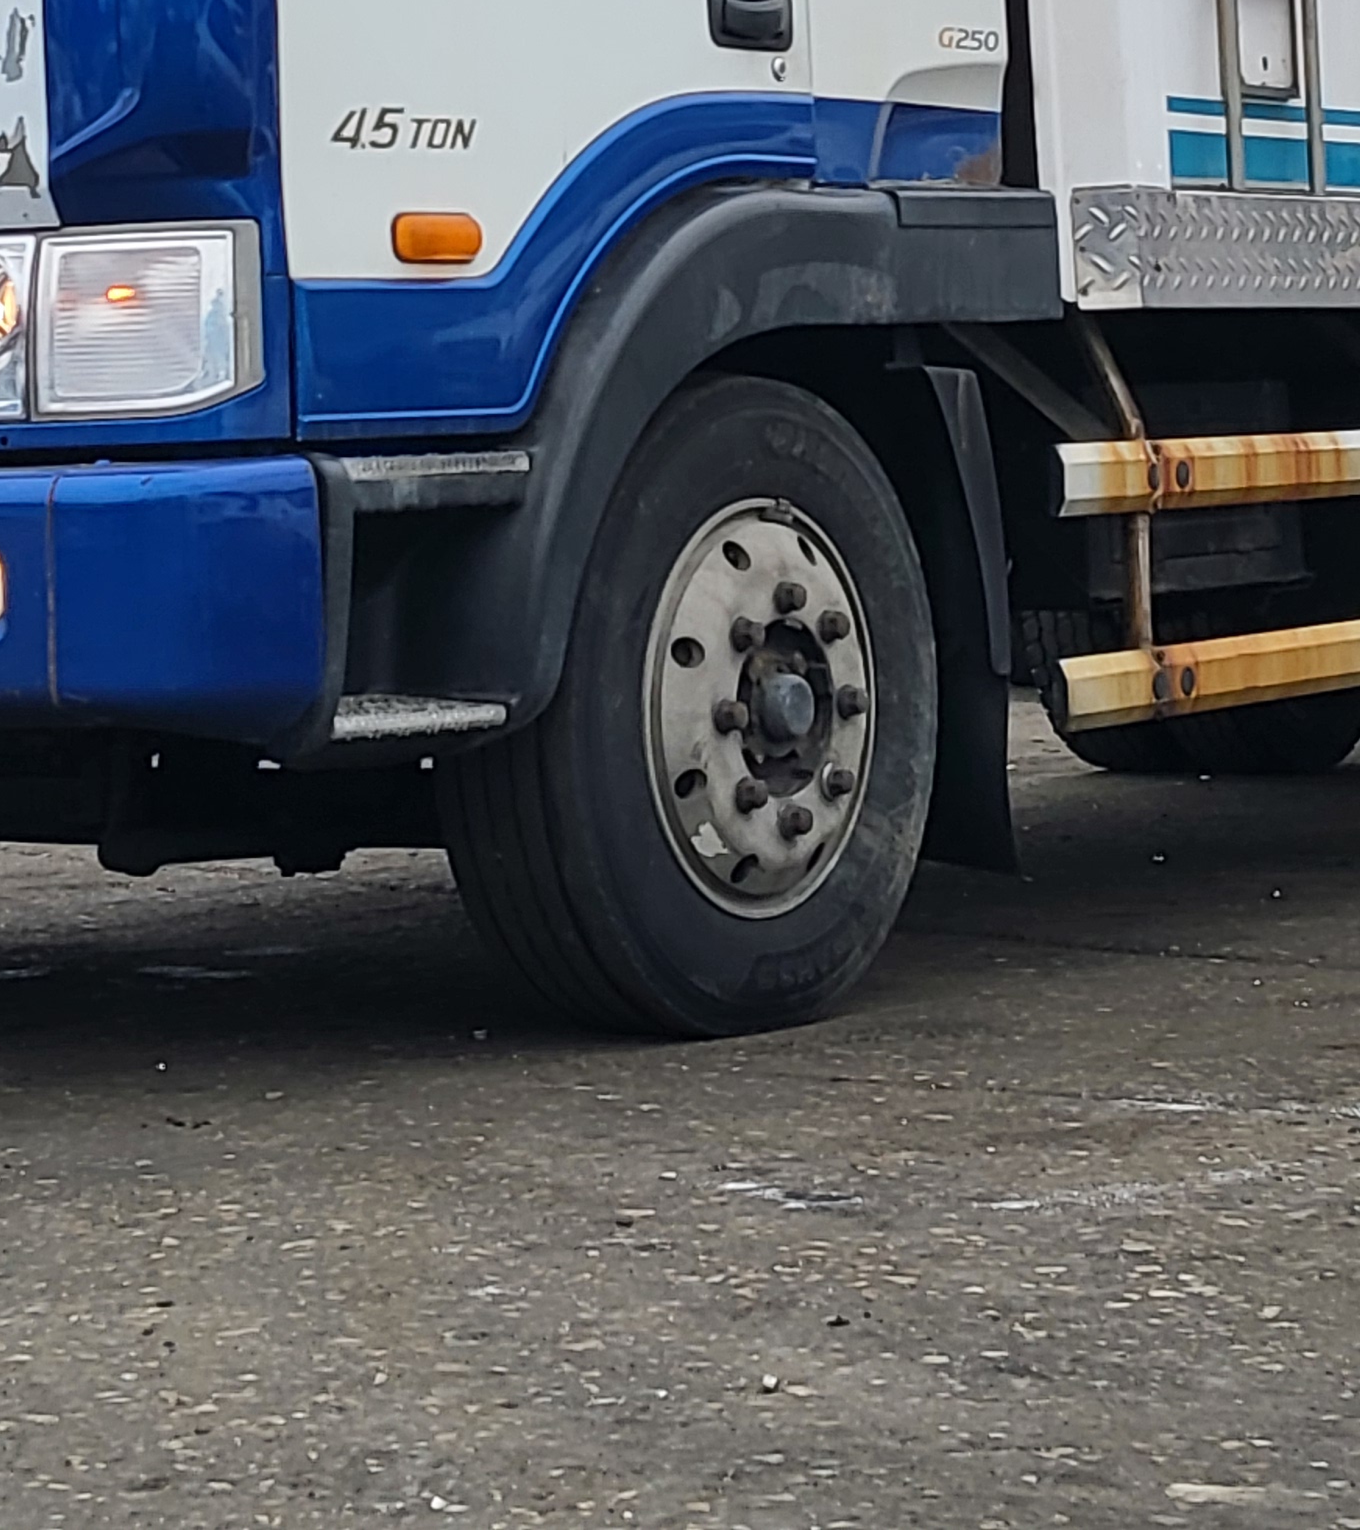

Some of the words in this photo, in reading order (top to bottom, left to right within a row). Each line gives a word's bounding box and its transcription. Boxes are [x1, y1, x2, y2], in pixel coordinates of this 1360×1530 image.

[938, 26, 999, 52] G250
[330, 107, 405, 149] 4.5
[409, 118, 476, 149] TON
